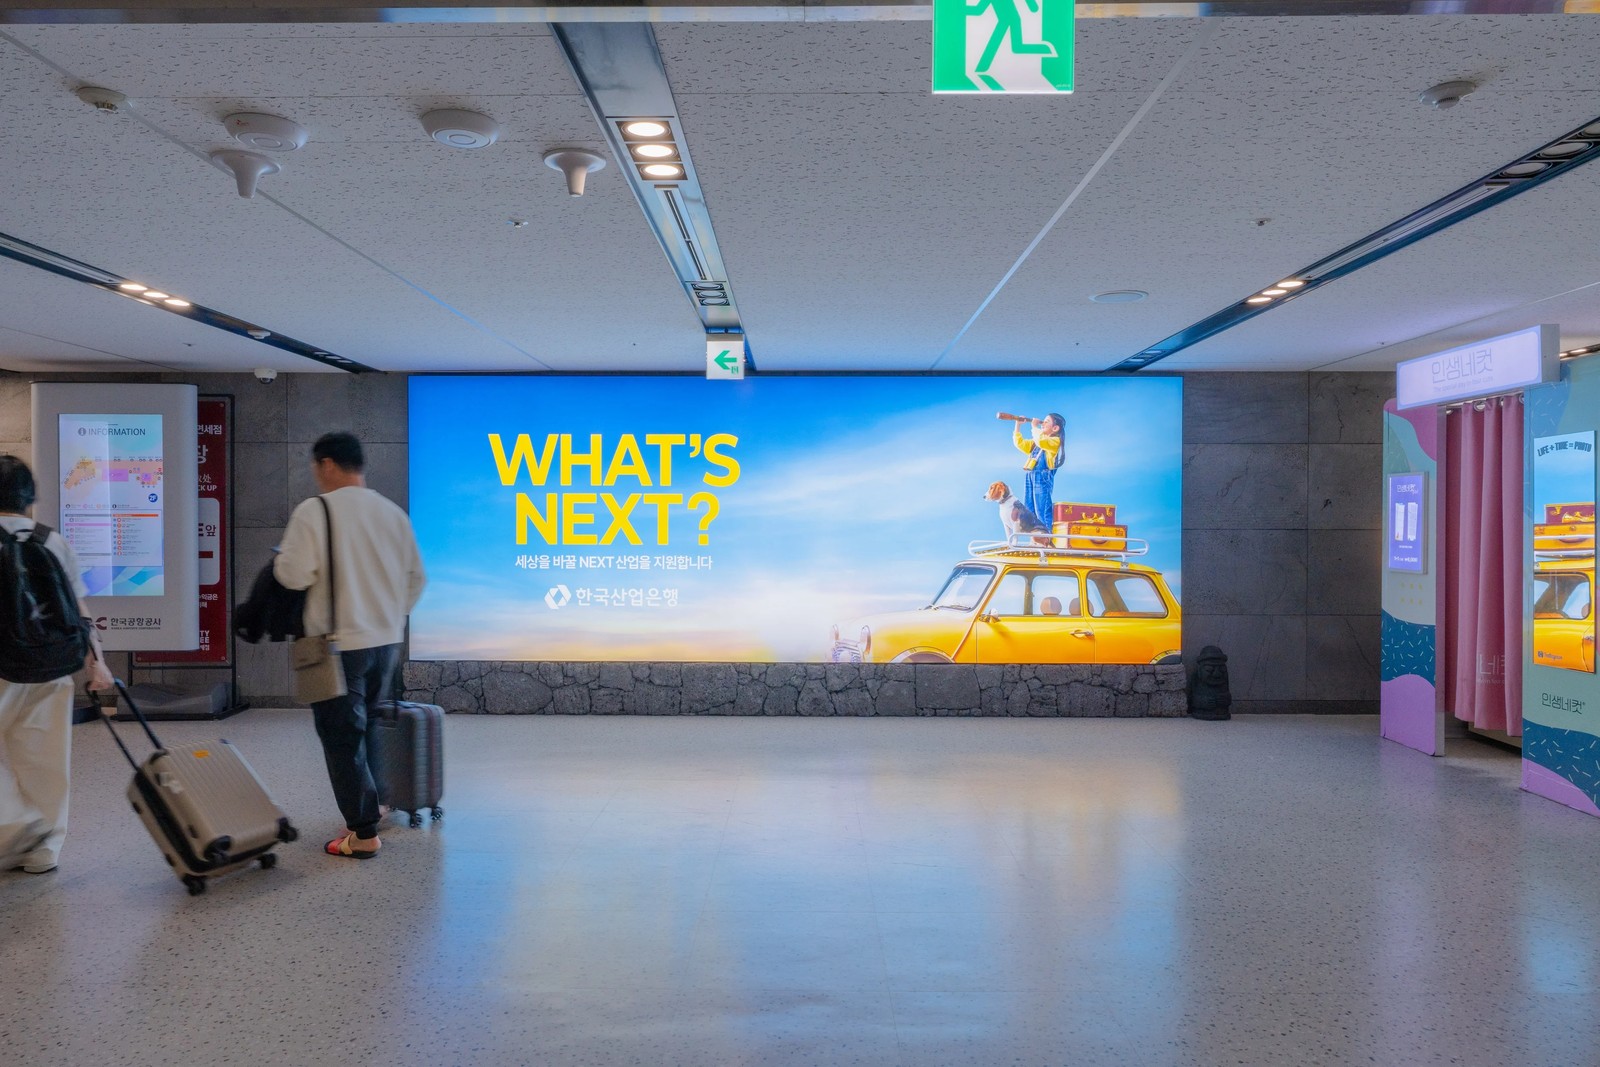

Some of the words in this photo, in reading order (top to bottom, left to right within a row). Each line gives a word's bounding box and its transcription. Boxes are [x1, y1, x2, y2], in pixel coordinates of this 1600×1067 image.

[1431, 348, 1493, 384] 인생네컷
[88, 428, 146, 436] INFORMATION
[1537, 445, 1549, 457] LIFE
[1574, 441, 1592, 452] PHOTO
[515, 491, 720, 546] NEXT?
[515, 555, 550, 569] 세상을
[553, 555, 577, 569] 바꿀
[579, 556, 614, 569] NEXT
[615, 555, 650, 570] 산업을
[654, 555, 713, 570] 지원합니다
[575, 587, 679, 607] 한국산업은행
[110, 617, 161, 626] 한국공항공사
[1541, 692, 1583, 715] 인생네컷
